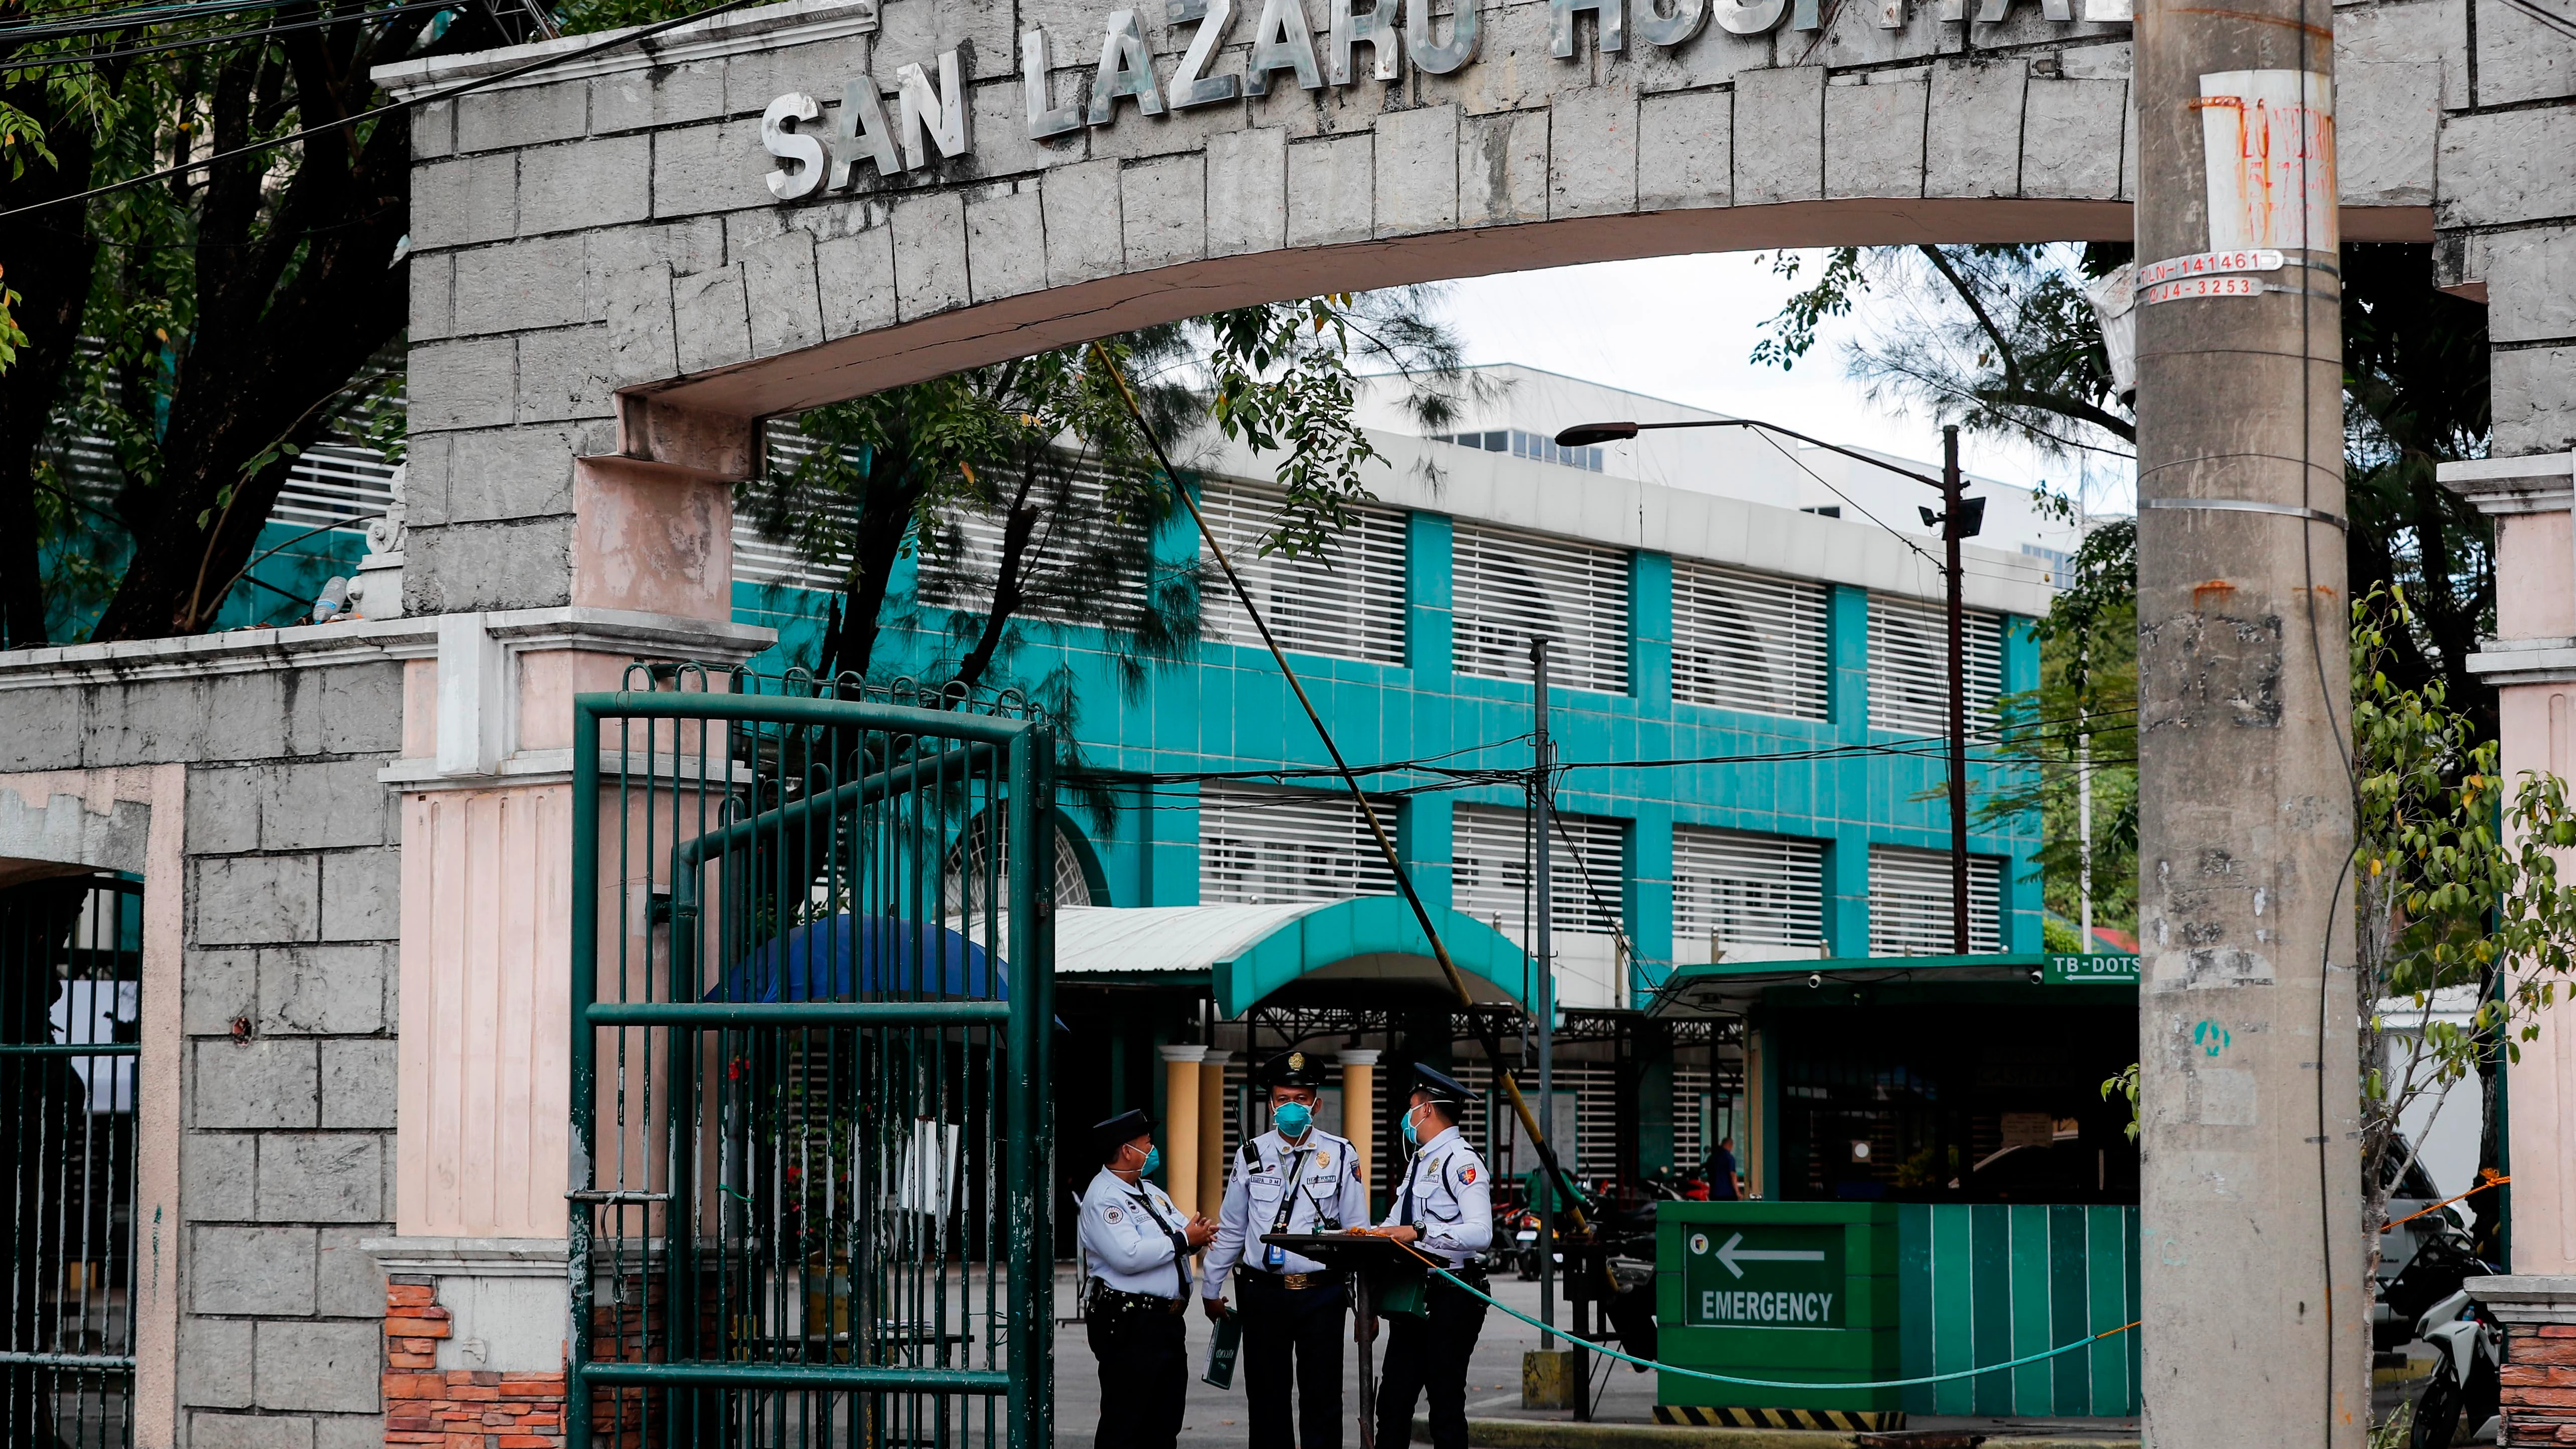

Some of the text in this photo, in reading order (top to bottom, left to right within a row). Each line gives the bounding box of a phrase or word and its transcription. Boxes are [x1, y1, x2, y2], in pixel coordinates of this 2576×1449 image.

[761, 49, 972, 200] SAN
[2053, 957, 2140, 972] TB-DOTS
[1703, 1290, 1833, 1322] EMERGENCY
